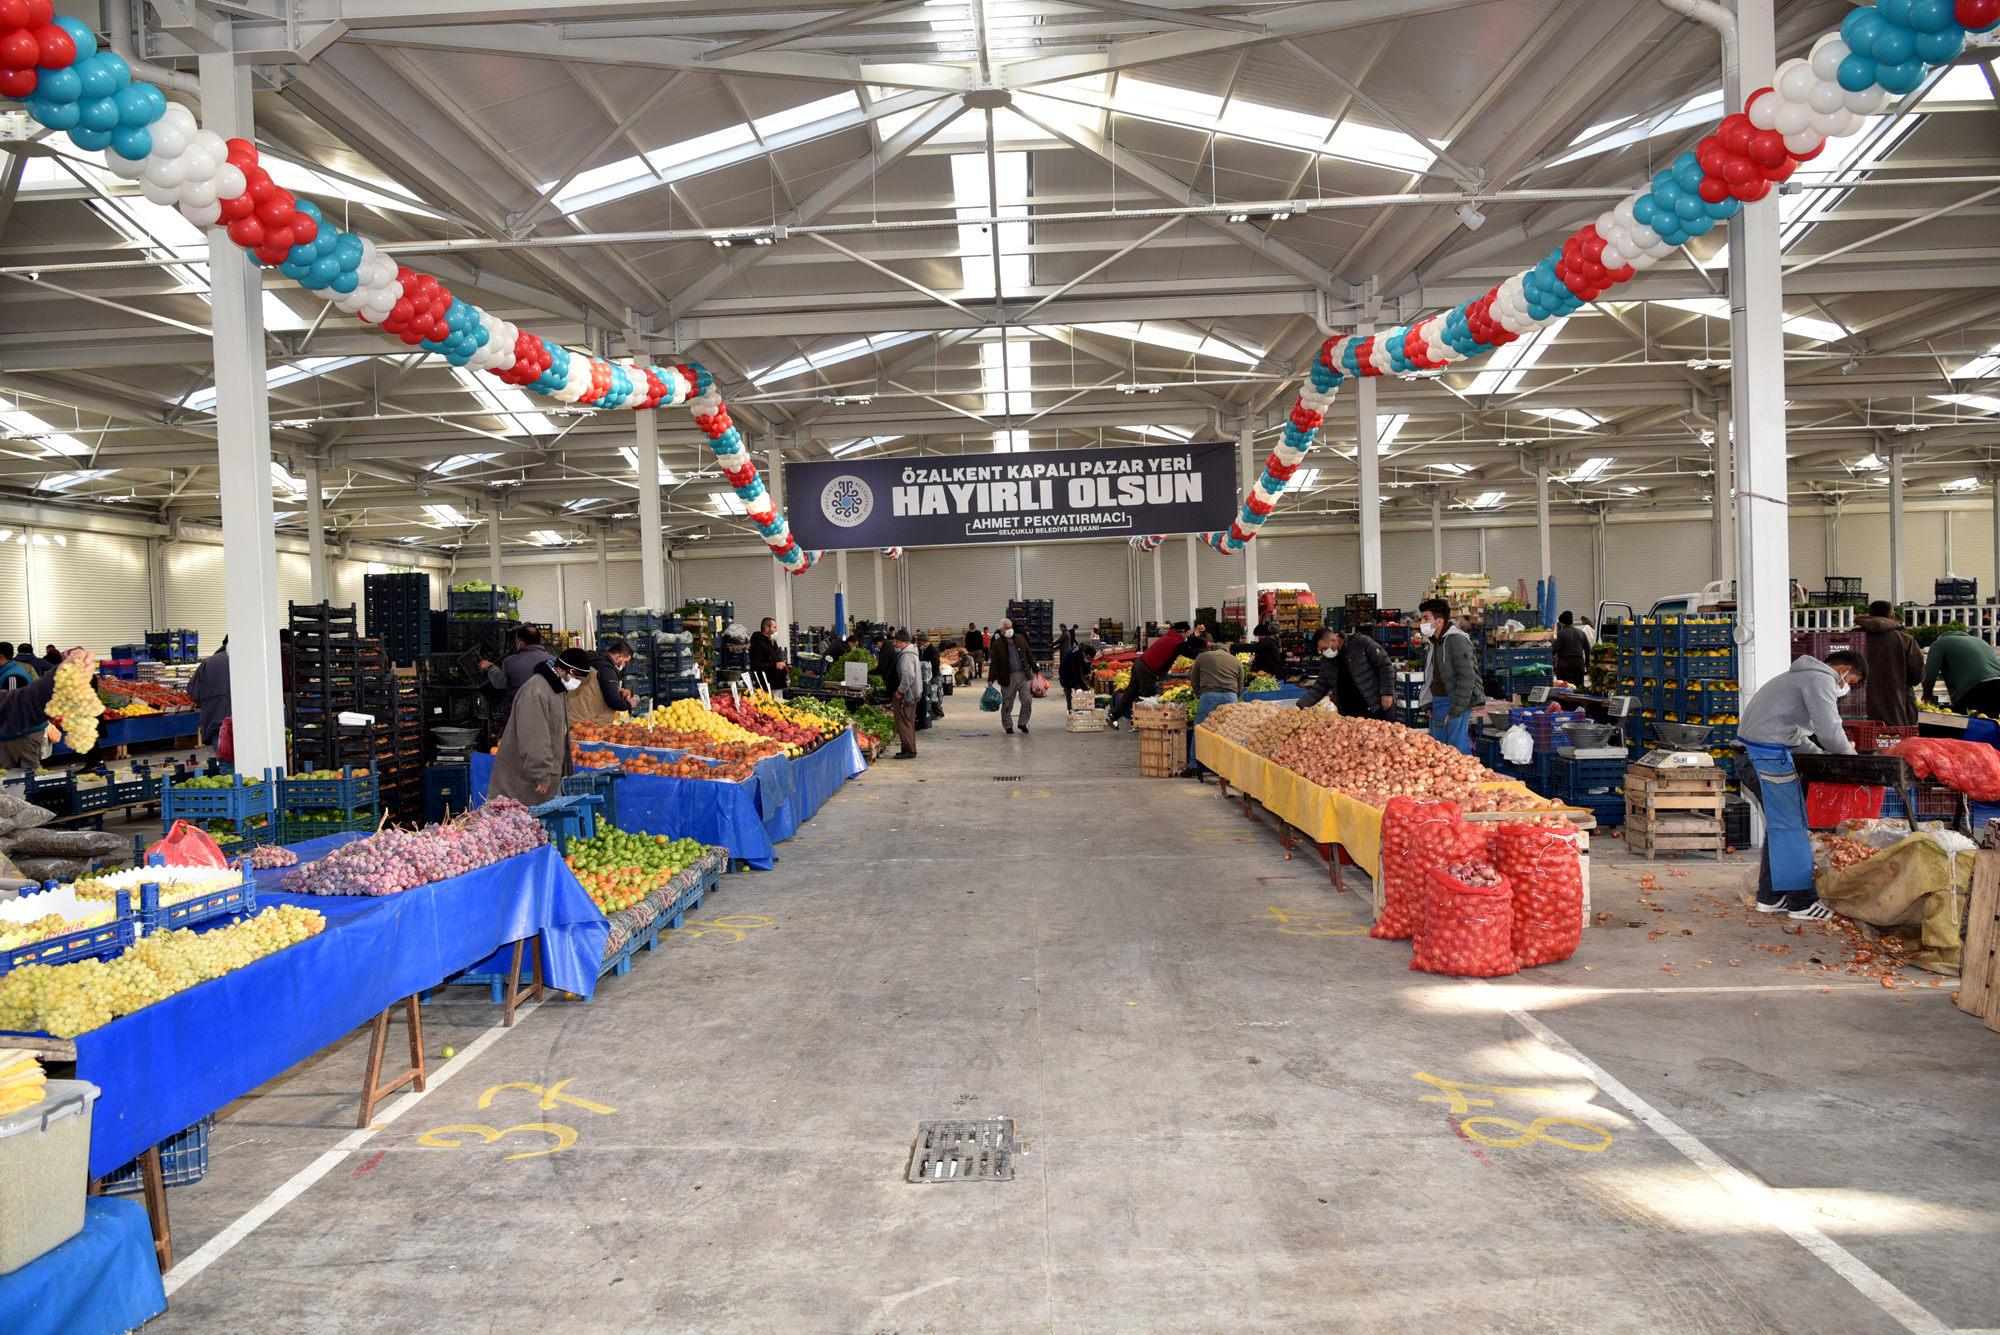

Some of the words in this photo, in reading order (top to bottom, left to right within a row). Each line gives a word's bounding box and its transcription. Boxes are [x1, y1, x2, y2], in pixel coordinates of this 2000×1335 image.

[902, 466, 1003, 484] ÖZALKENT
[1007, 463, 1076, 479] KAPALI
[1080, 459, 1144, 475] PAZAR
[1148, 453, 1192, 472] YERİ
[892, 480, 1053, 516] HAYIRLI
[1068, 472, 1203, 508] OLSUN
[972, 516, 1020, 530] AHMET
[1024, 511, 1126, 527] PEKYATIRMACI
[998, 528, 1034, 536] SELÇUKLU
[1035, 525, 1068, 534] BELEDİYE
[1069, 524, 1100, 533] BAŞKANI
